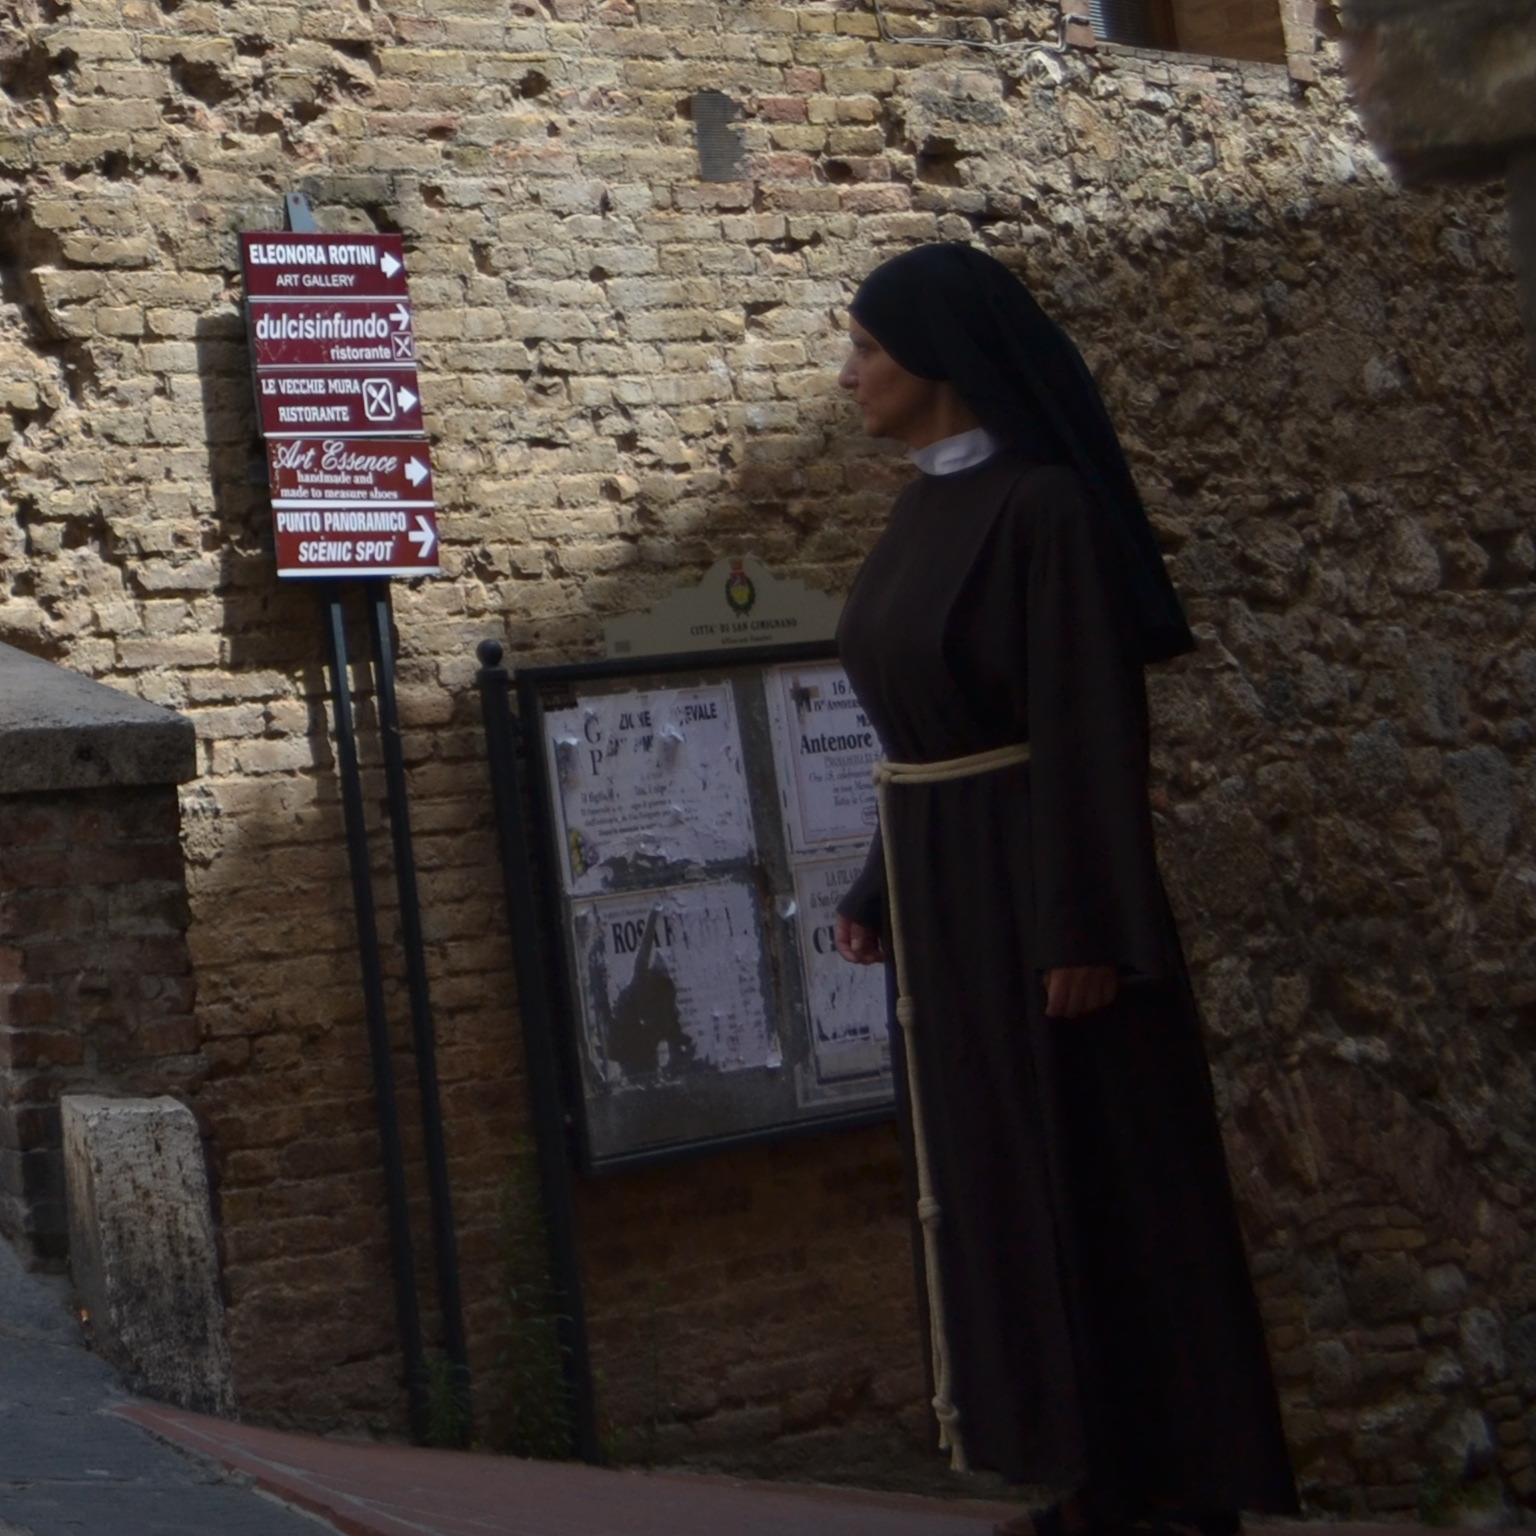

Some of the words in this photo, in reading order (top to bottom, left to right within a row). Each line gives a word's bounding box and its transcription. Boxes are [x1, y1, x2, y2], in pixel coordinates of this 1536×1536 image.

[248, 244, 327, 265] ELEONORA
[328, 245, 376, 265] ROTINI
[276, 274, 299, 287] ART
[301, 274, 355, 288] GALLERY
[255, 312, 389, 340] dulcisinfundo
[330, 345, 392, 361] ristorante
[261, 378, 277, 395] LE
[278, 378, 326, 395] VECCHIE
[328, 378, 361, 395] MURA
[278, 406, 350, 422] RISTORANTE
[272, 440, 316, 469] Art
[321, 440, 398, 474] Essence
[296, 470, 351, 485] handmade
[353, 471, 374, 485] and
[280, 485, 309, 498] made
[310, 487, 323, 498] to
[324, 487, 368, 500] measure
[368, 487, 399, 500] shoes
[277, 512, 321, 533] PUNTO
[324, 512, 407, 532] PANORAMICO
[298, 541, 353, 563] SCENIC
[355, 541, 394, 561] SPOT
[720, 623, 730, 633] DI
[732, 622, 748, 633] SAN
[832, 680, 846, 695] 16
[800, 732, 873, 755] Antenore
